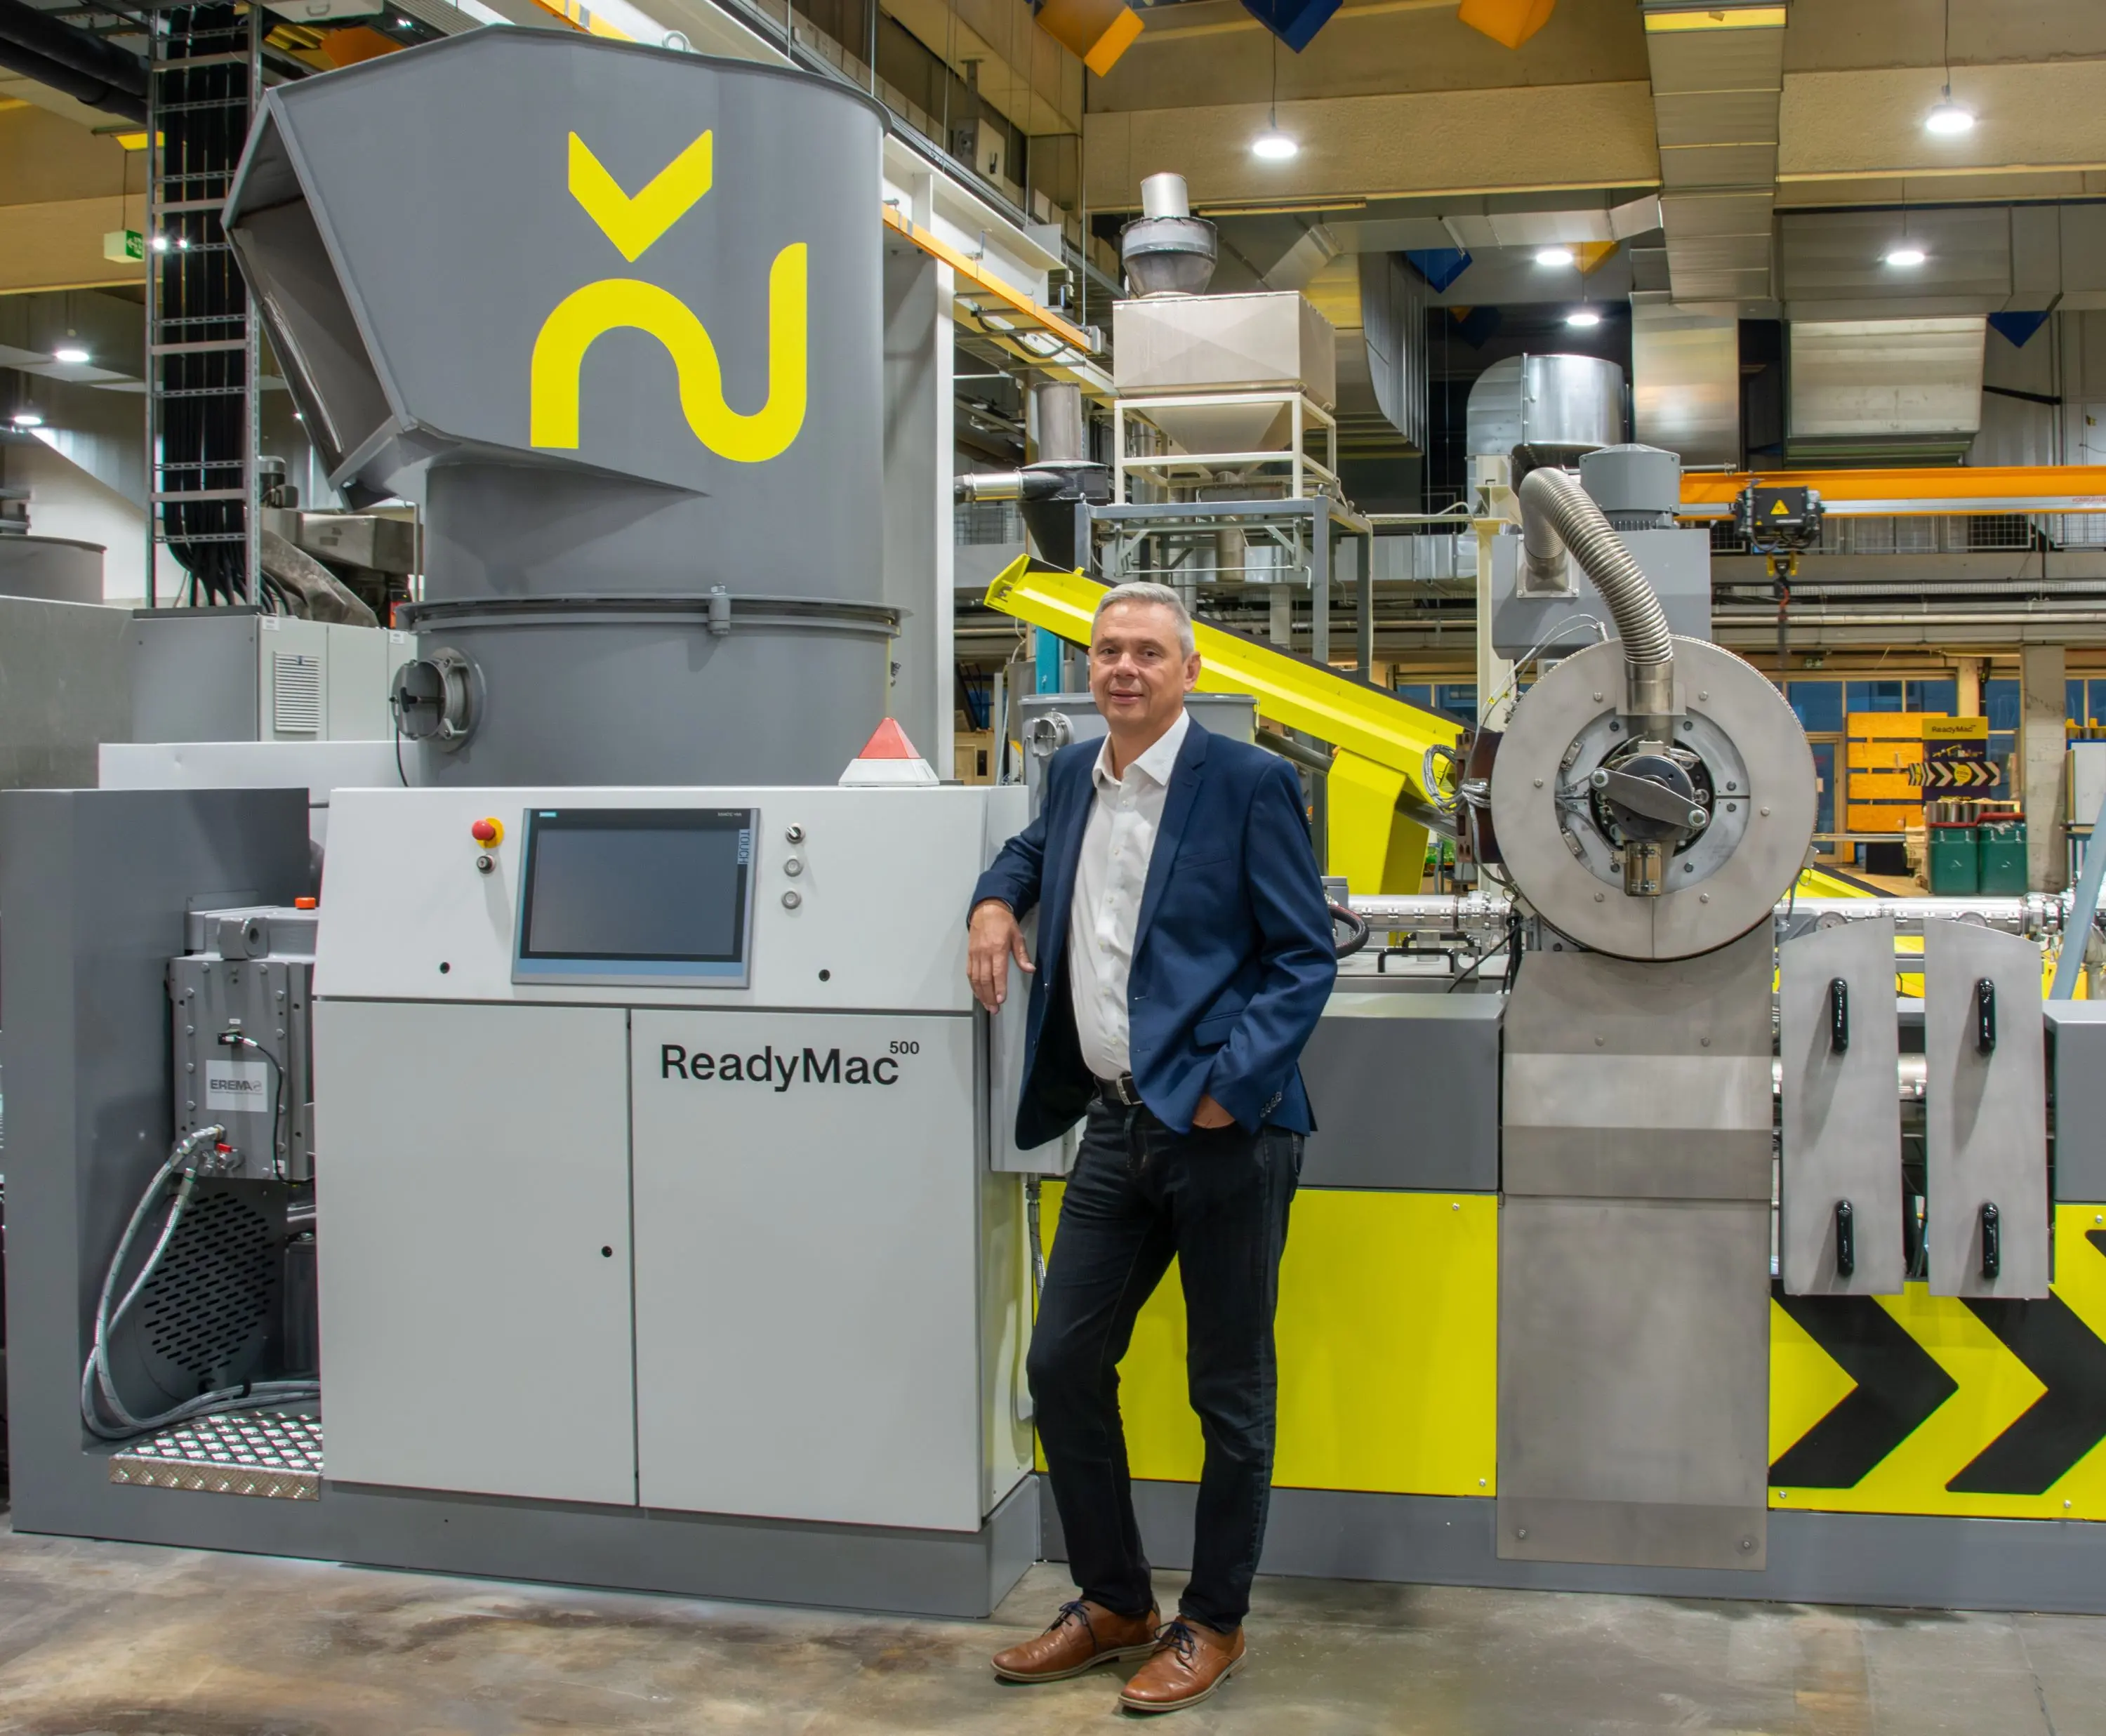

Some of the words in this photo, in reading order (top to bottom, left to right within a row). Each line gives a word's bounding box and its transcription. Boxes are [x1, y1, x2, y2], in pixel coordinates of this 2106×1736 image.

[739, 830, 750, 863] TOUCH
[661, 1044, 899, 1092] ReadyMac
[889, 1040, 920, 1054] 500
[210, 1079, 253, 1091] EREMA
